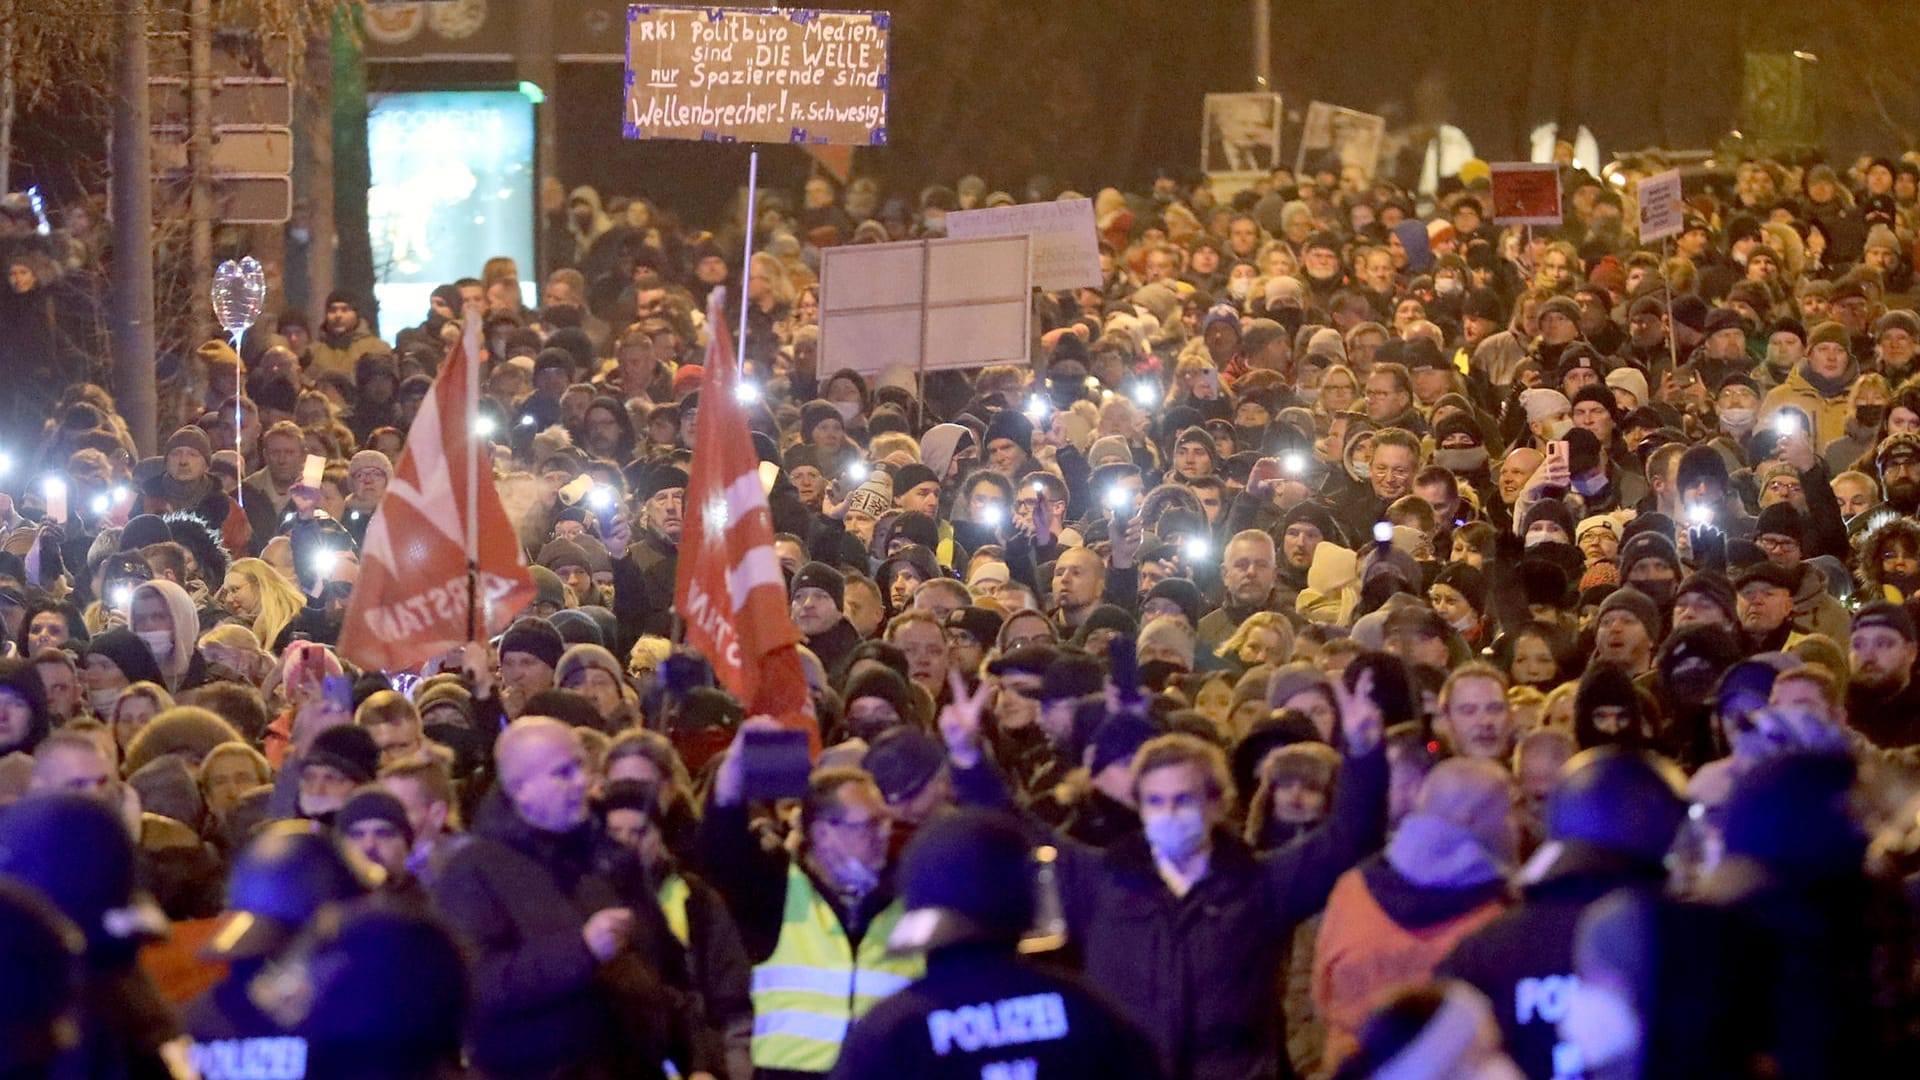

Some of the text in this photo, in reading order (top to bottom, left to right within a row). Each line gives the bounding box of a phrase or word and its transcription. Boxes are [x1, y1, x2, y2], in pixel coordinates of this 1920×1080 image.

[640, 15, 878, 43] RKI Politbüro Medien
[691, 42, 733, 63] sind
[647, 63, 880, 90] nur Spazierende sind
[632, 88, 886, 129] Wellenbrecher! Fr. Schwesig!
[927, 992, 1069, 1056] POLIZEI
